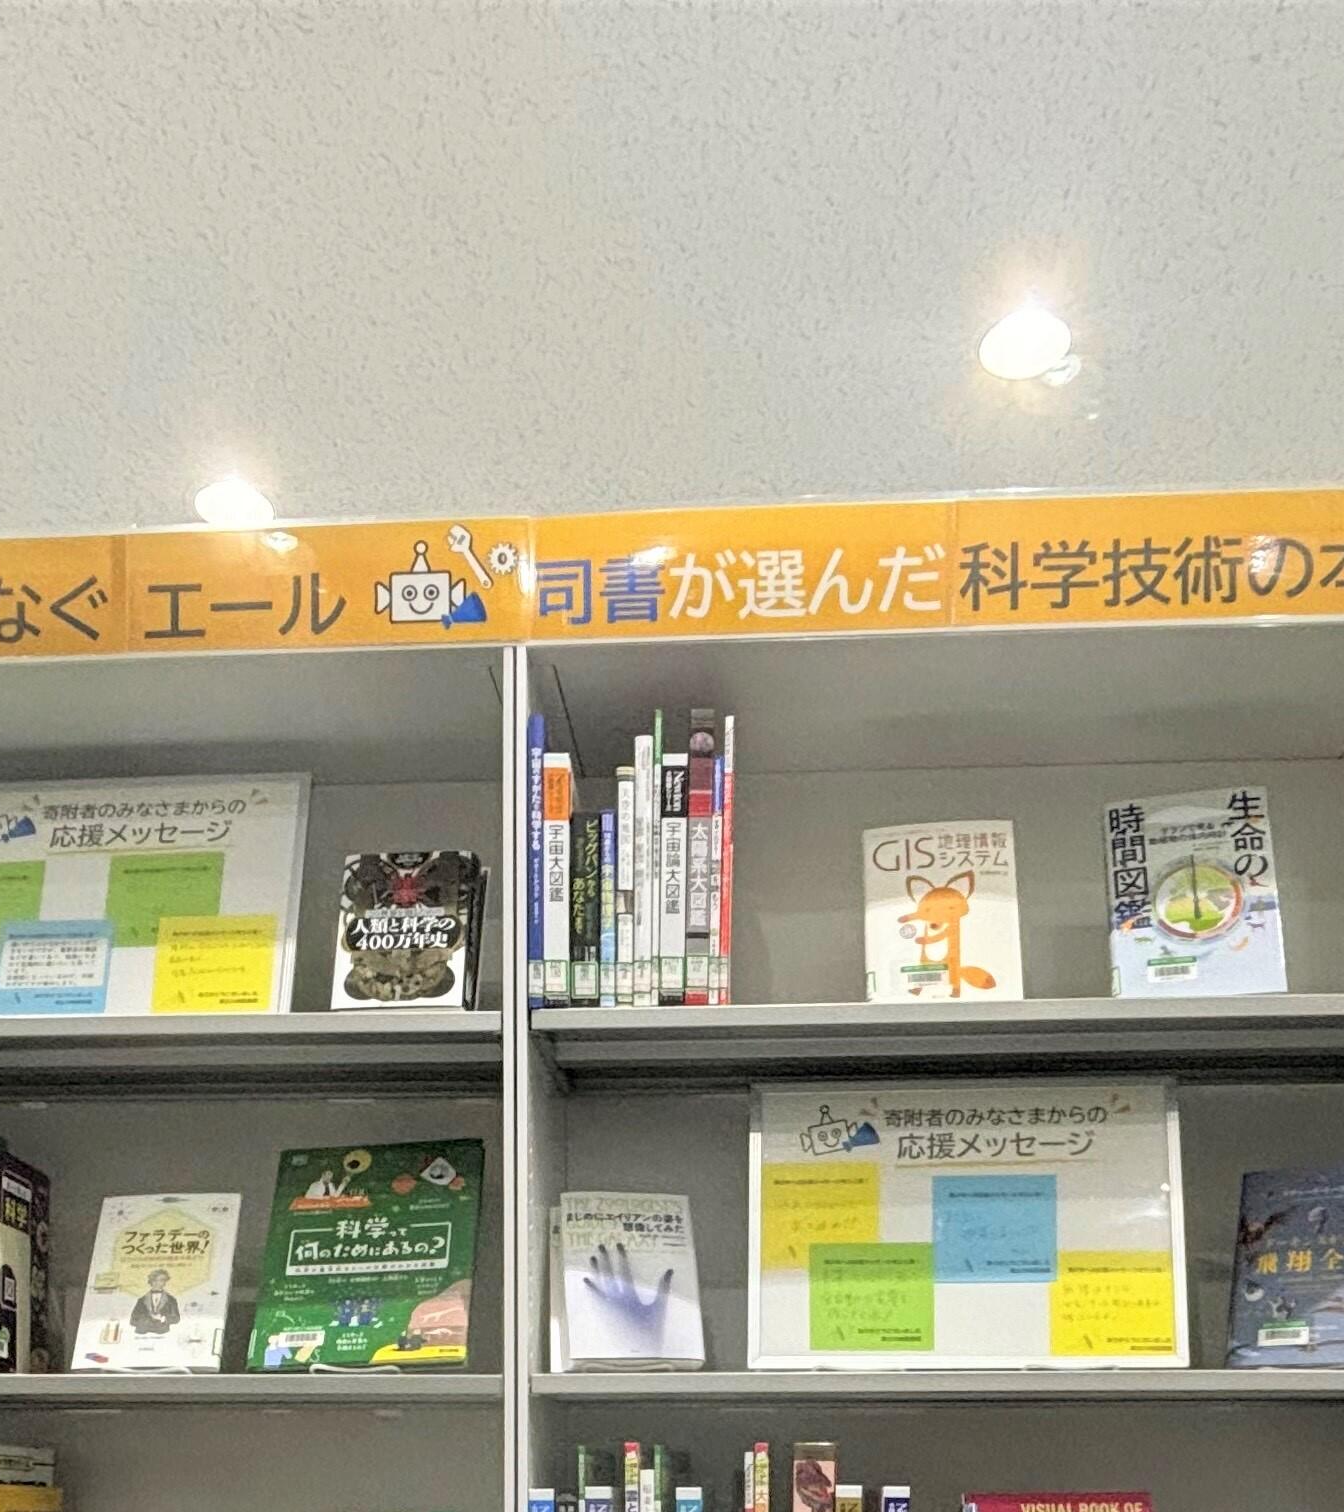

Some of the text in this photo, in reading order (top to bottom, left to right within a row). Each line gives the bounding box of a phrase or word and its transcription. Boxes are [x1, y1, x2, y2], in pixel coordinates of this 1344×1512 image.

[145, 573, 347, 640] エール
[539, 542, 945, 625] 司書が選んだ
[42, 798, 246, 820] 寄附者のみなさまからの
[49, 820, 232, 849] 応援メッセージ
[938, 833, 1007, 849] 地理情報
[1228, 791, 1269, 886] 生命の
[548, 824, 564, 902] 宇宙大図鑑
[872, 837, 935, 872] GIS
[940, 851, 1008, 868] システム
[1109, 804, 1153, 930] 時間図鑑
[666, 822, 680, 914] 宇宙論大図鑑
[690, 824, 707, 928] 太陽系大図鑑
[351, 917, 455, 935] 人類と科学の
[356, 933, 448, 950] 400万年史
[883, 1105, 1108, 1126] 寄附者のみなさまからの
[896, 1130, 1096, 1160] 応援メッセージ
[124, 1229, 209, 1243] ファラデーの
[336, 1216, 408, 1239] 科学って
[122, 1240, 209, 1254] つくった世界!
[295, 1236, 445, 1261] 何のためにあるの?
